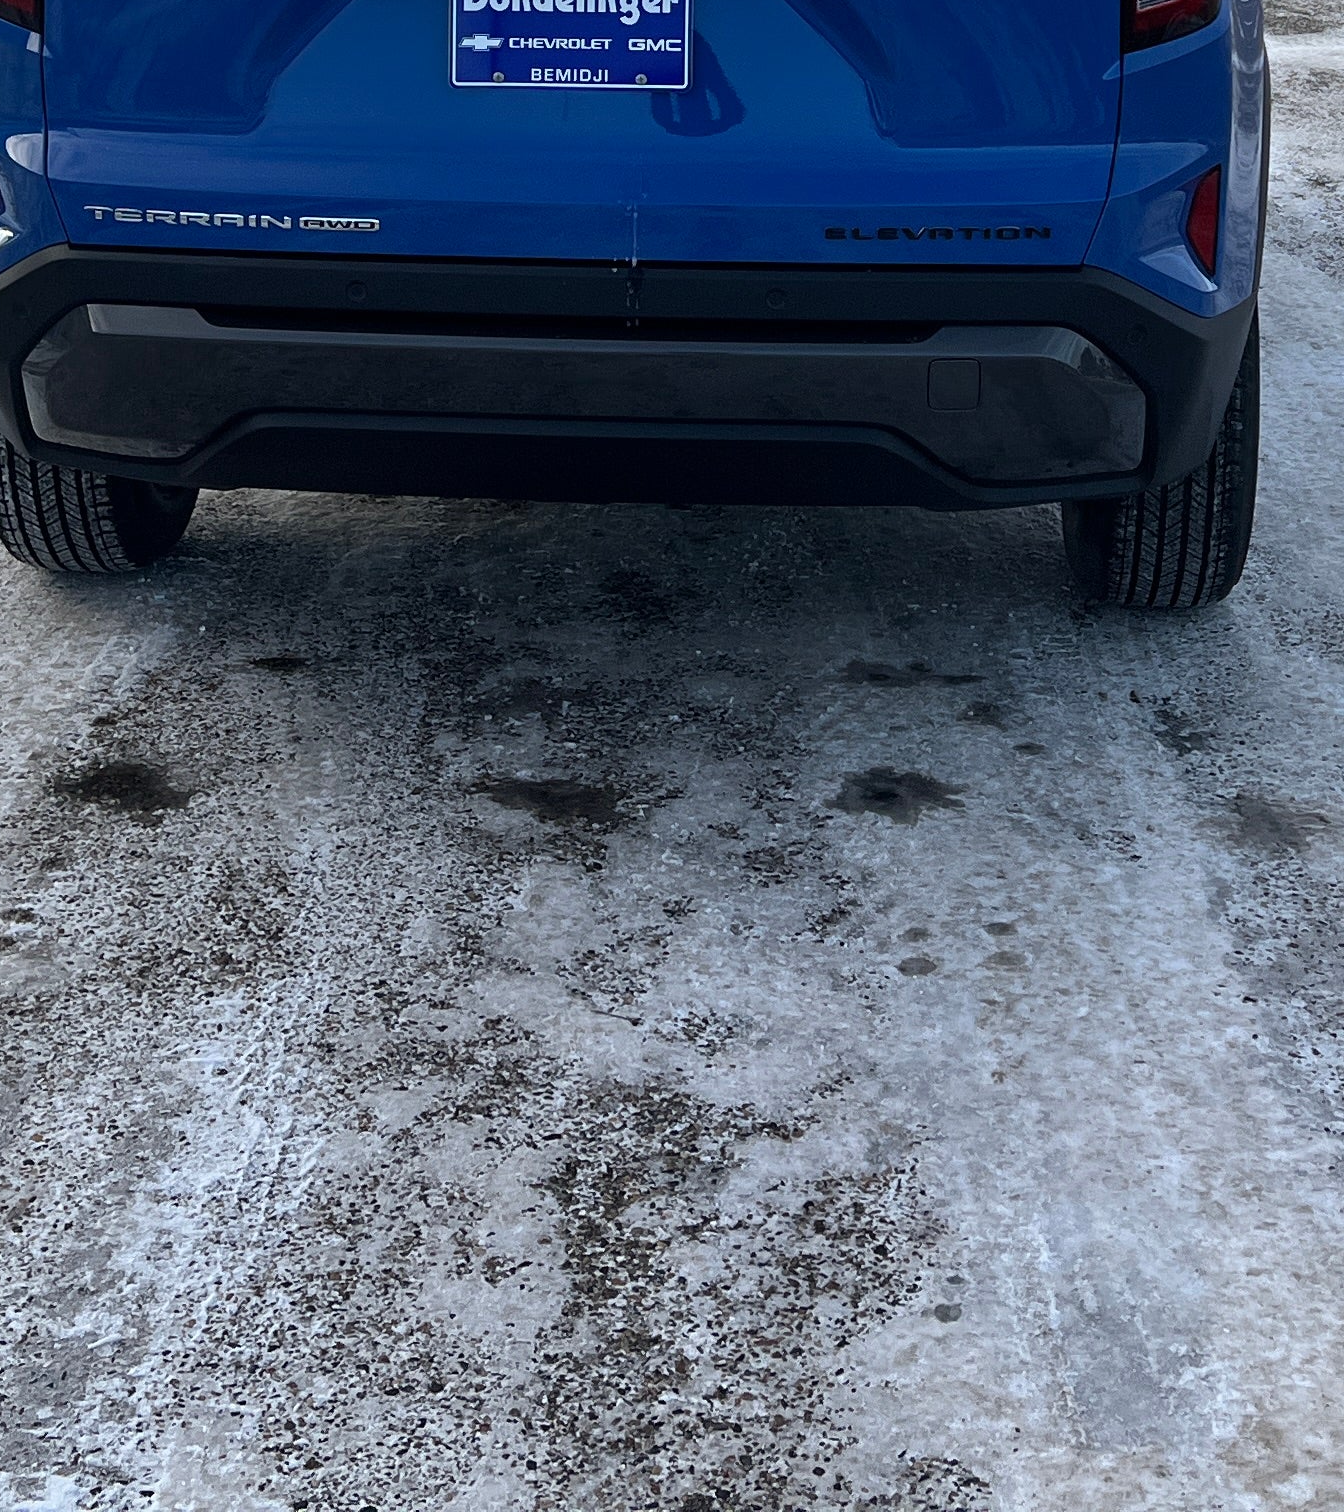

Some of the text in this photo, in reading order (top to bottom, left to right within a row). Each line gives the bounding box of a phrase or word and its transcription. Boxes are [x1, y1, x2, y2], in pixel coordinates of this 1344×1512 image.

[508, 37, 682, 51] CHEVROLET GMC
[530, 68, 609, 83] BEMIDJI
[83, 205, 376, 231] TERRAIN AWD
[824, 226, 1052, 241] ELEVATION
